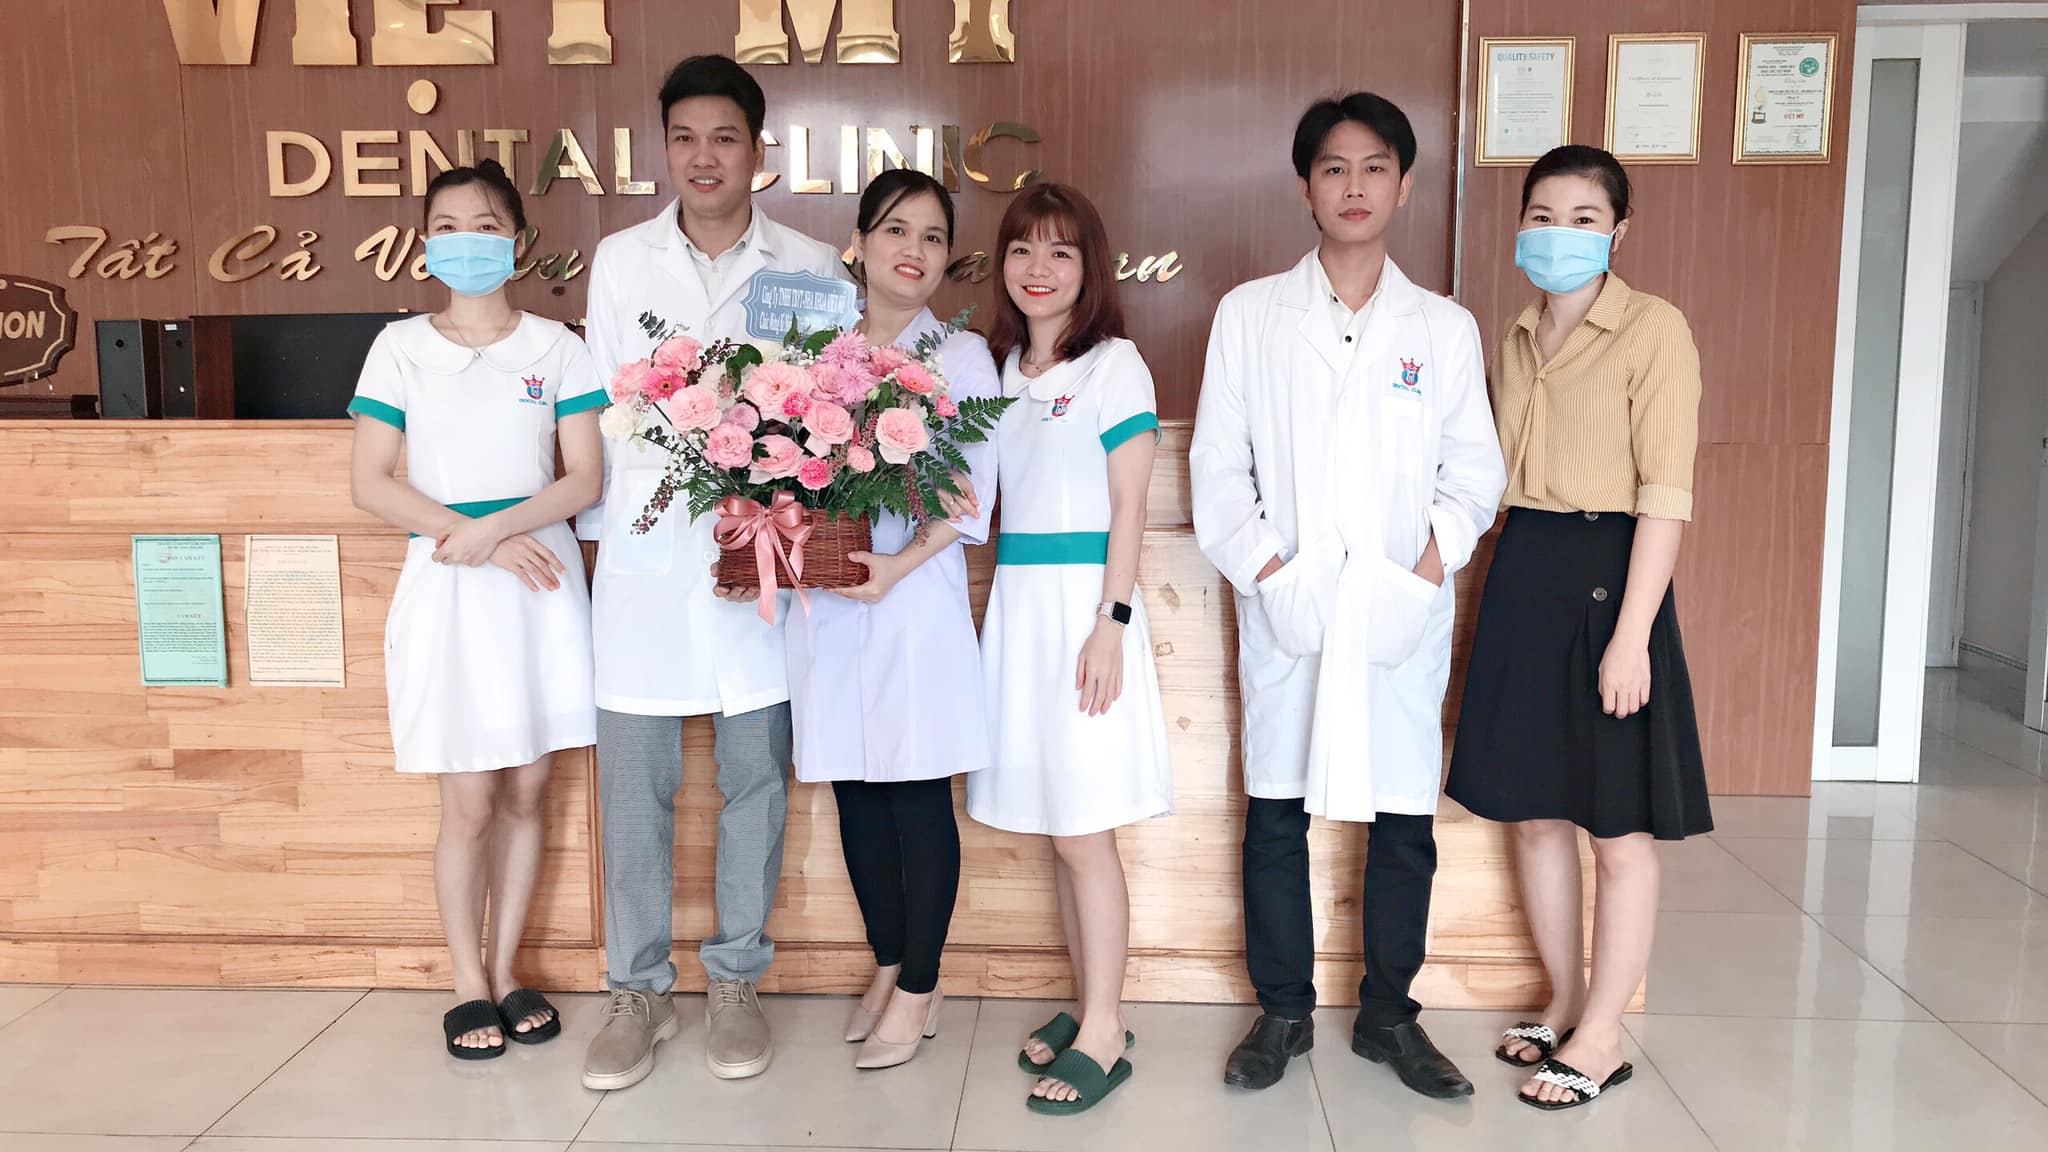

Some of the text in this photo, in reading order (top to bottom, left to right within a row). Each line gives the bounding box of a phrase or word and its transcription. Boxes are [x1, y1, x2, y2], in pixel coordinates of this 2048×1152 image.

[266, 127, 656, 197] DENTAL
[46, 225, 179, 280] Tất
[208, 225, 322, 283] Cả
